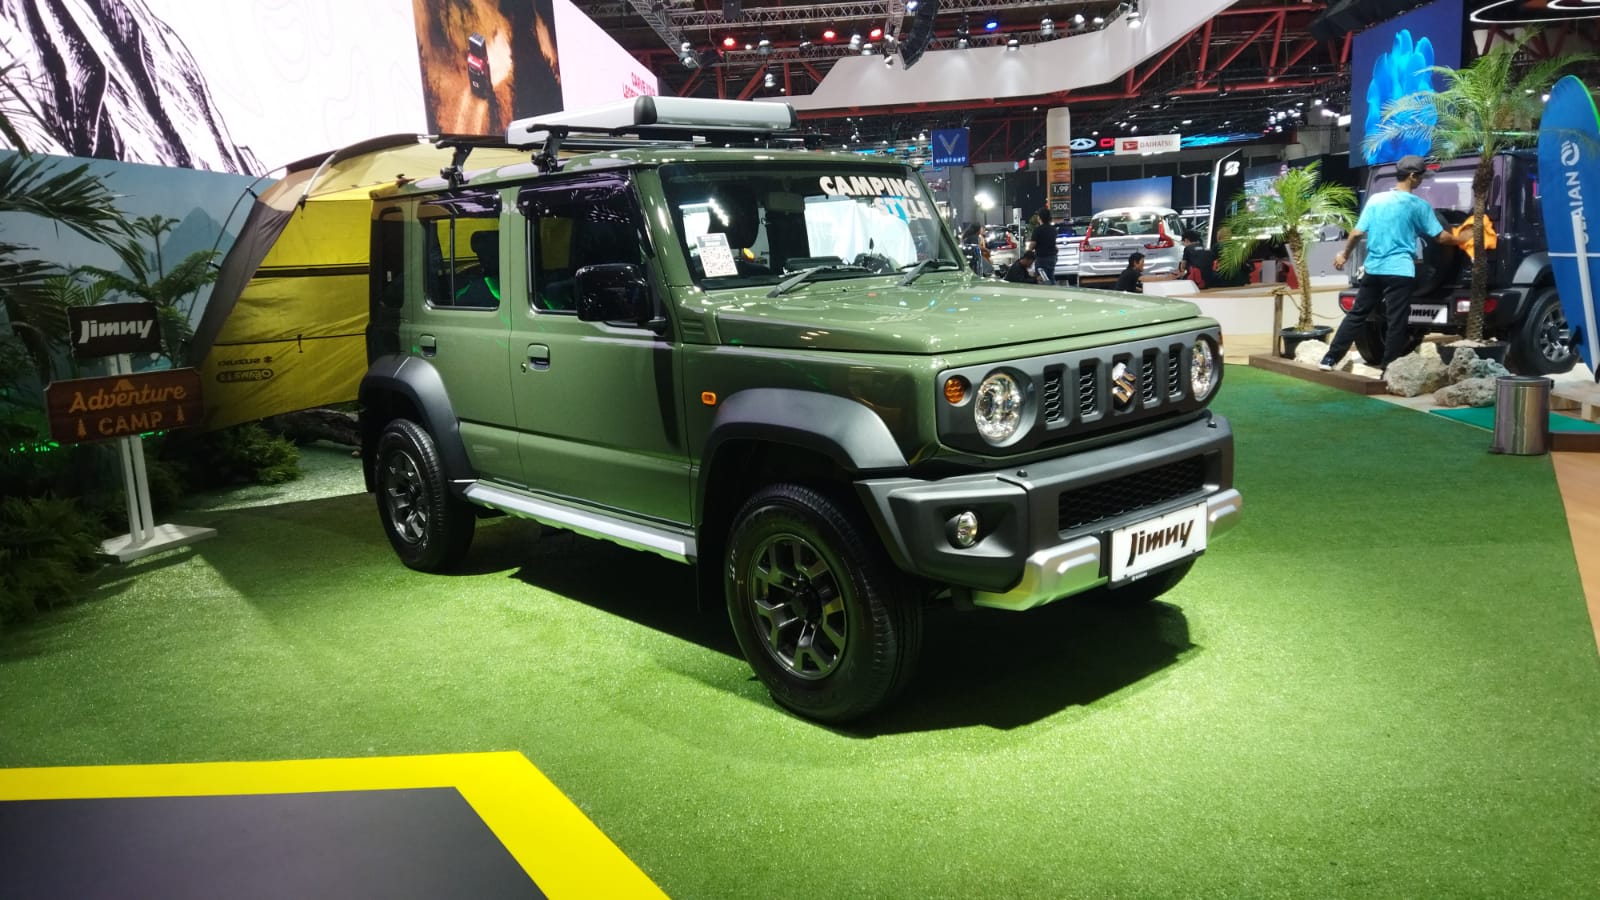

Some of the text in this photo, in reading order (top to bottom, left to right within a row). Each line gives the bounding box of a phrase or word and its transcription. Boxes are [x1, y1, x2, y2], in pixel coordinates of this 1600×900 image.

[1140, 140, 1173, 148] DAIHATSU
[819, 176, 920, 199] CAMPING
[873, 197, 932, 220] STYLE
[78, 320, 153, 344] Jimny
[69, 384, 187, 413] Adventure
[98, 411, 163, 435] CAMP
[1126, 519, 1194, 568] Jimny
